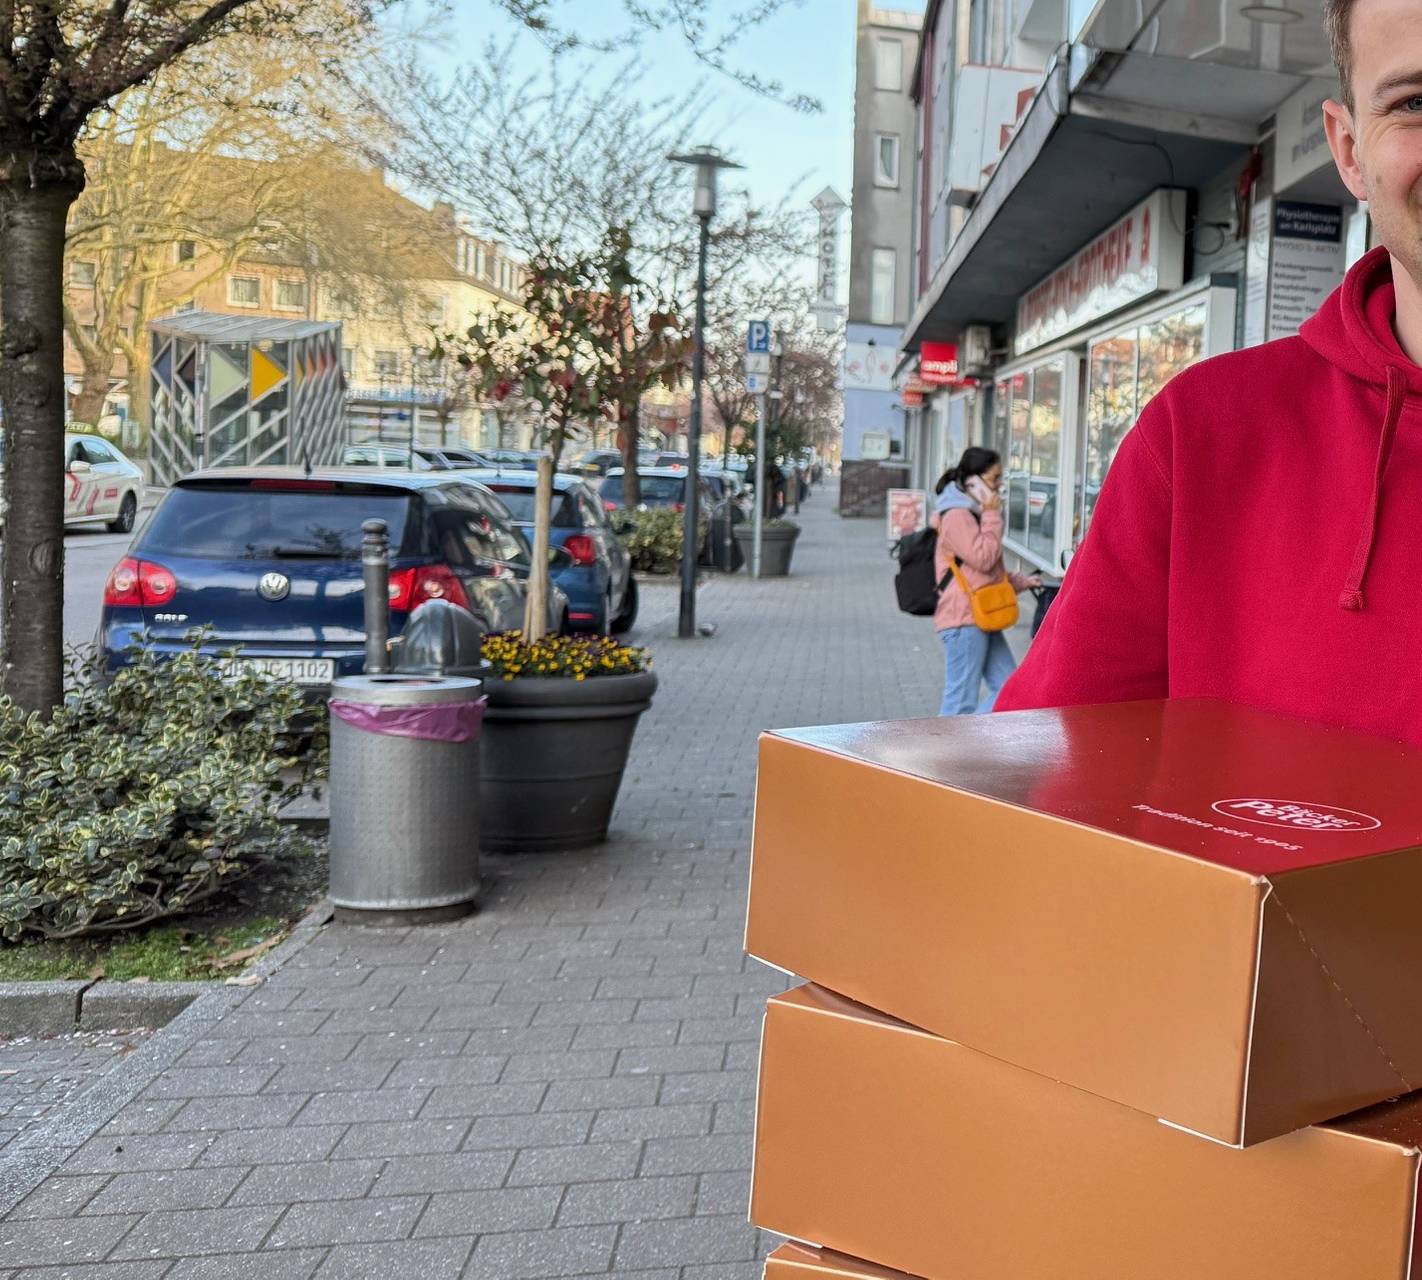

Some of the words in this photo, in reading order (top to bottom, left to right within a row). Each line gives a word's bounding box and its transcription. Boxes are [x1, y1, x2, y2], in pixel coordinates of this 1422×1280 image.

[752, 323, 766, 351] P
[287, 661, 329, 679] 1102
[1131, 804, 1214, 828] Tradition
[1213, 826, 1254, 838] seit
[1254, 836, 1304, 851] 1905
[1230, 800, 1343, 829] Peter
[1277, 804, 1361, 826] Bäcker
